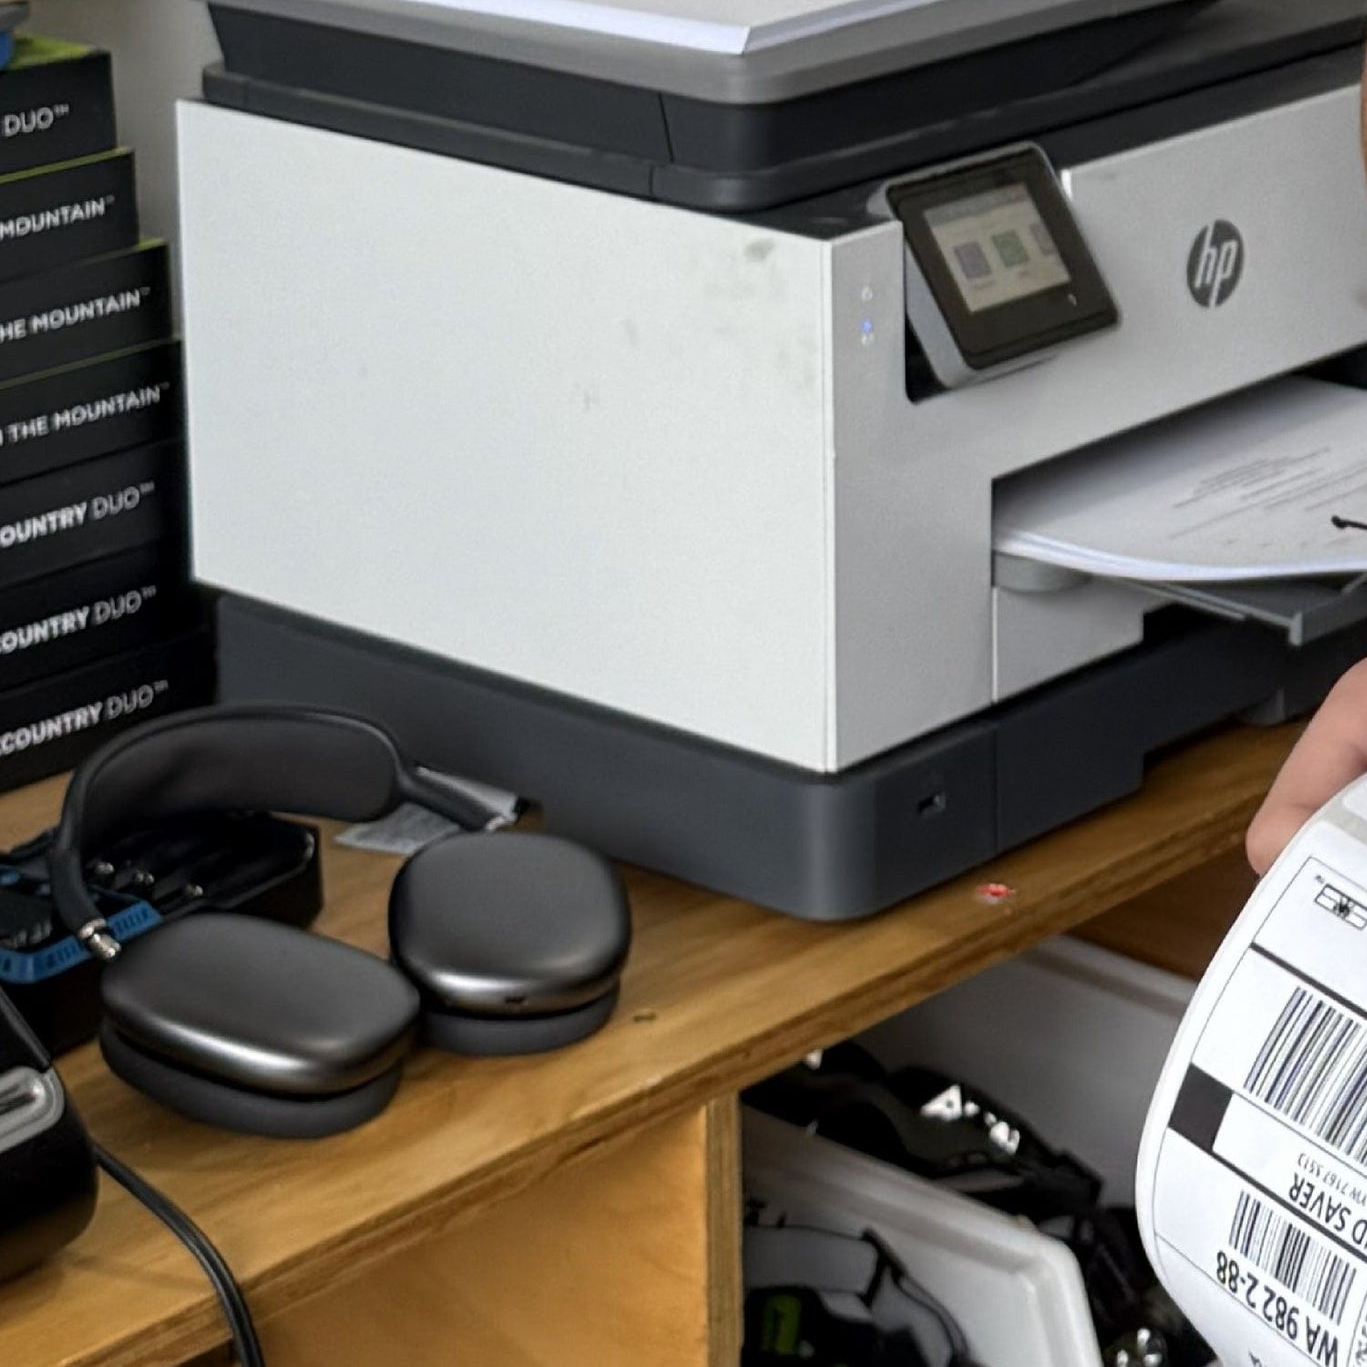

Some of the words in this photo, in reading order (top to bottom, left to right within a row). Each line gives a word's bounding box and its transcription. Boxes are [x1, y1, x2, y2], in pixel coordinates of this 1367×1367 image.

[1191, 220, 1241, 308] hp
[0, 318, 26, 342] HE
[8, 415, 48, 442] THE
[0, 502, 87, 547] OUNTRY
[0, 606, 89, 653] OUNTRY
[0, 702, 103, 756] COUNTRY
[1289, 1172, 1352, 1232] SAVER
